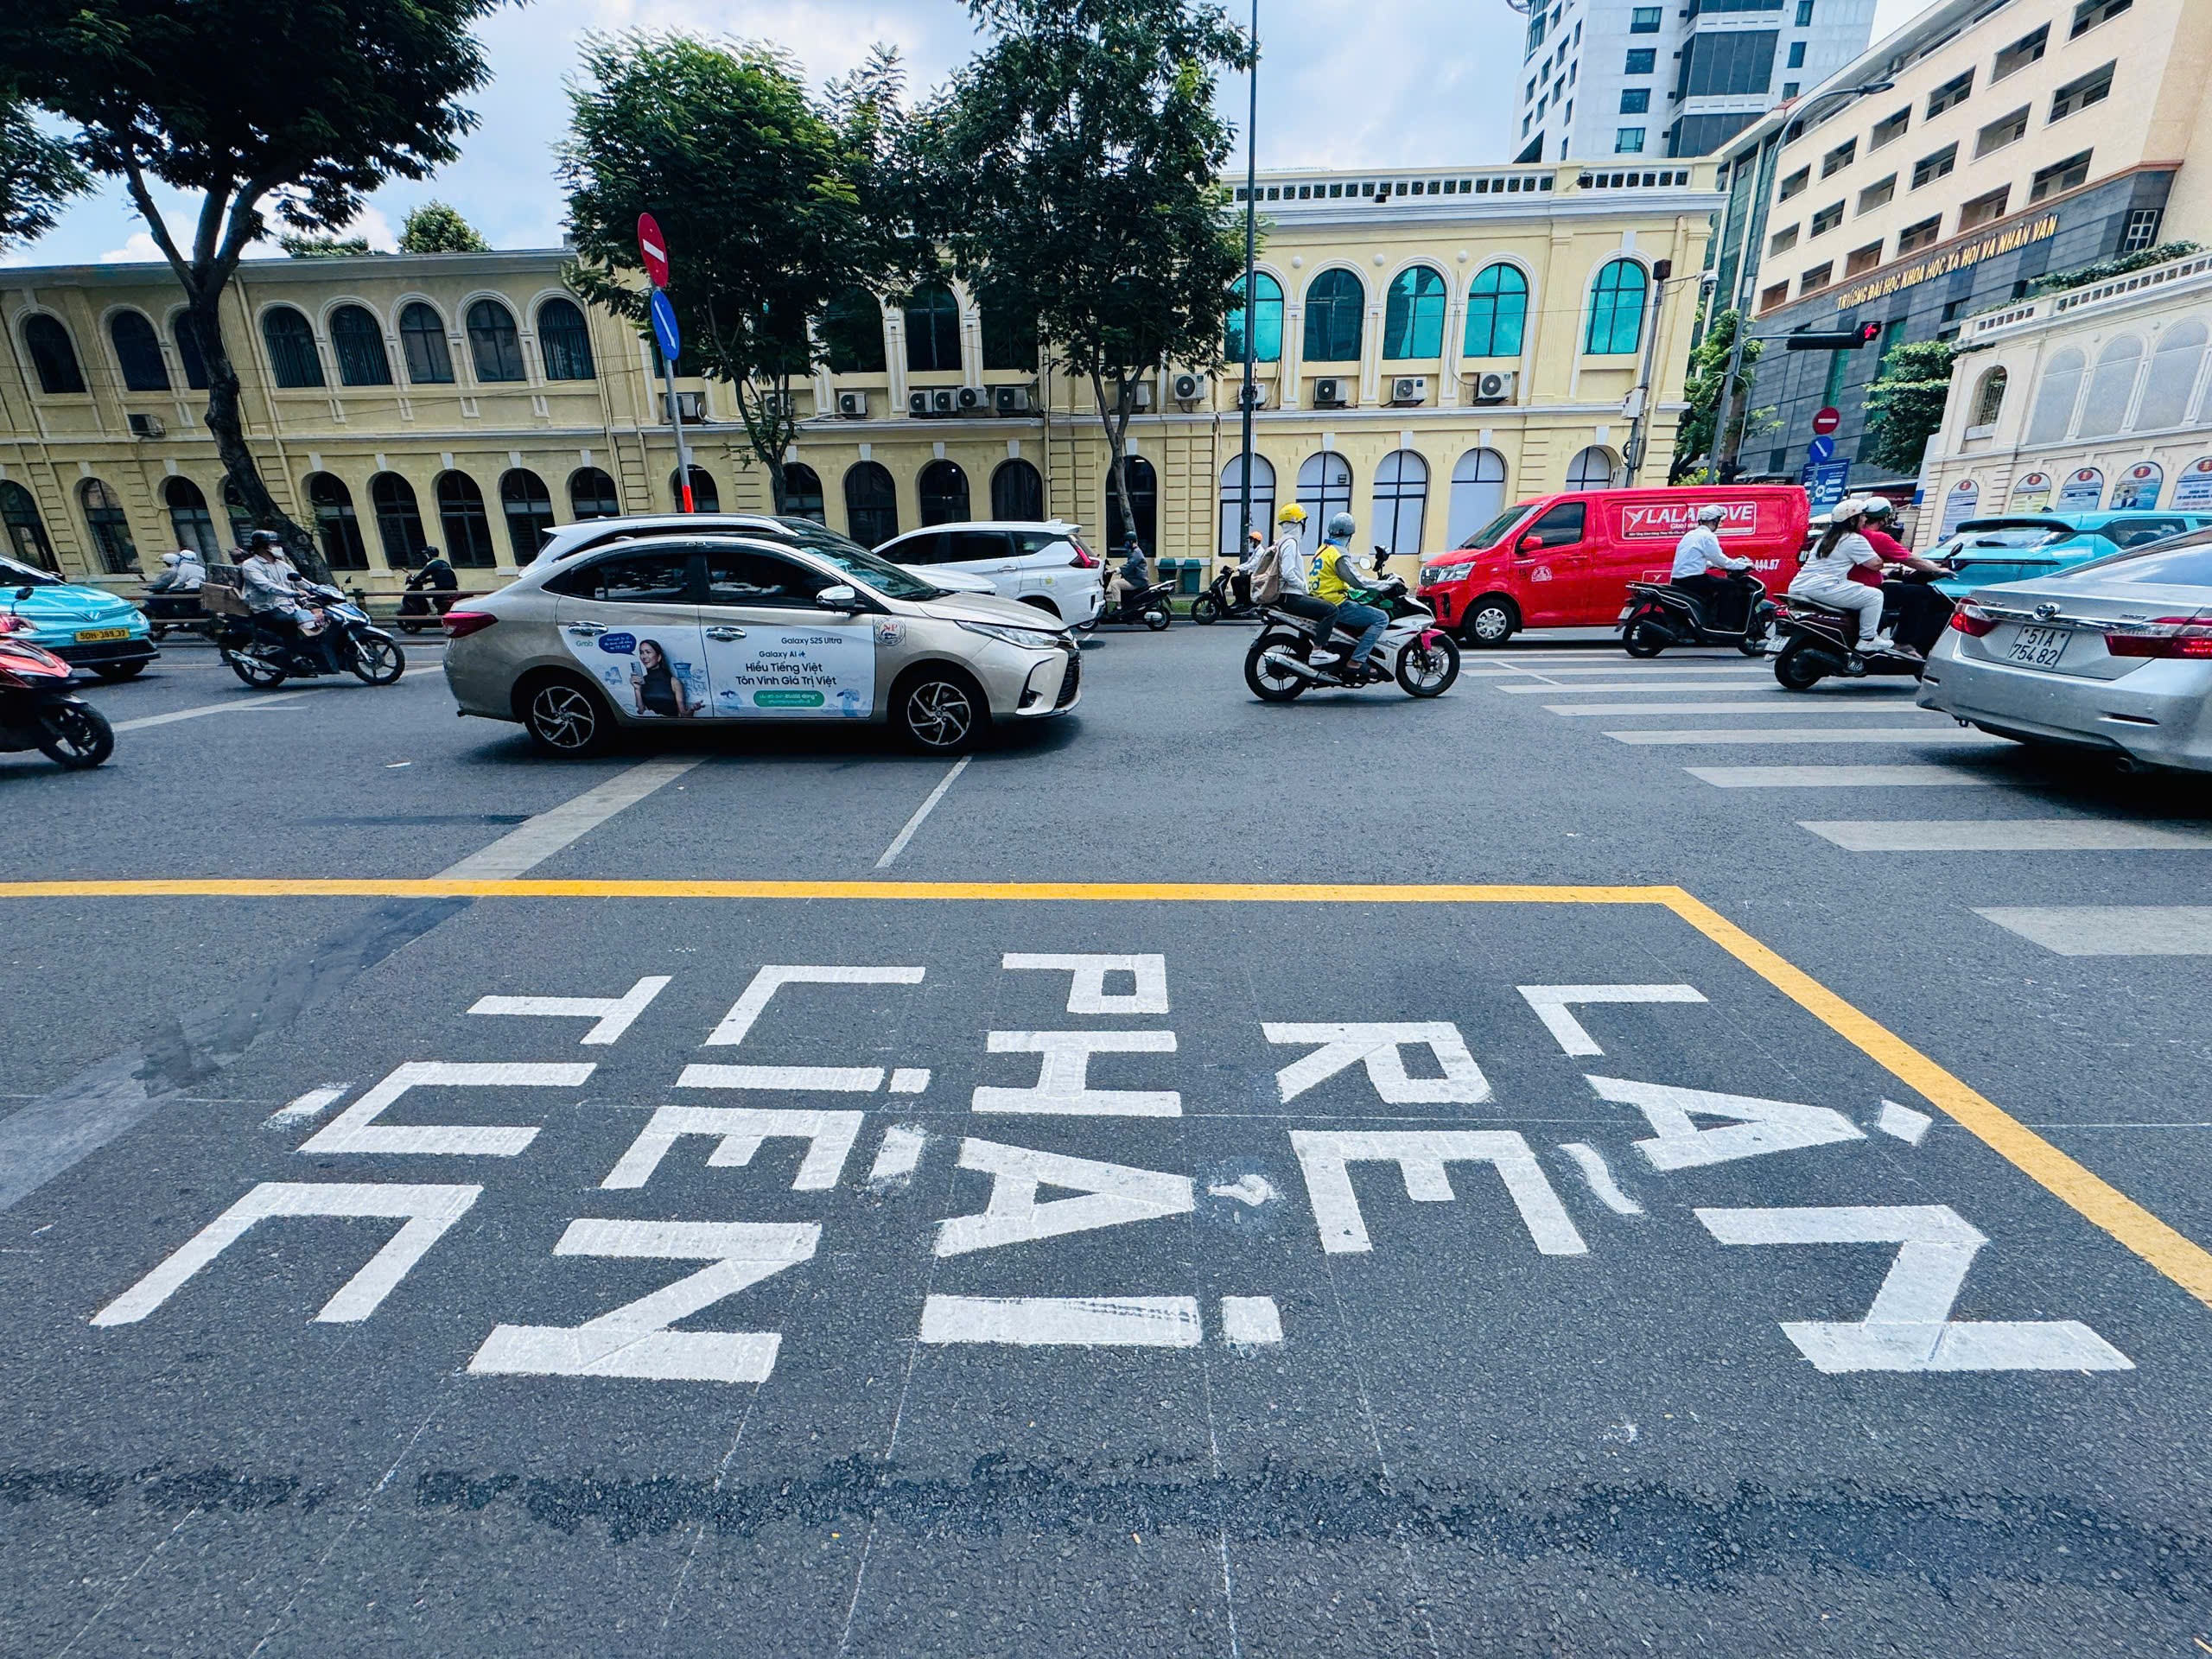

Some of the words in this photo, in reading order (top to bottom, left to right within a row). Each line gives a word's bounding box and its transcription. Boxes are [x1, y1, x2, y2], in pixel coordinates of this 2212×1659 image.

[1837, 285, 1868, 311] TRƯỜNG
[1867, 280, 1883, 302] ĐẠI
[1883, 274, 1901, 297] HỌC
[1901, 264, 1925, 289] KHOA
[1925, 257, 1946, 283] HỌC
[1961, 241, 1980, 270] HỘI
[1997, 223, 2031, 254] NHÂN
[2032, 213, 2058, 241] VĂN
[1646, 505, 1753, 524] LALAVE
[781, 637, 809, 645] Galaxy
[2027, 629, 2055, 648] 51A
[759, 651, 787, 659] Galaxy
[2009, 644, 2058, 665] 754.82
[746, 661, 768, 672] Hiểu
[771, 661, 800, 674] Tiếng
[802, 663, 823, 673] Việt
[736, 676, 754, 685] Tôn
[757, 676, 779, 685] Vinh
[781, 676, 799, 685] Giá
[802, 676, 815, 688] Trị
[817, 676, 837, 687] Việt
[1262, 1022, 1643, 1254] RẼ
[1516, 983, 2138, 1372] LÀN
